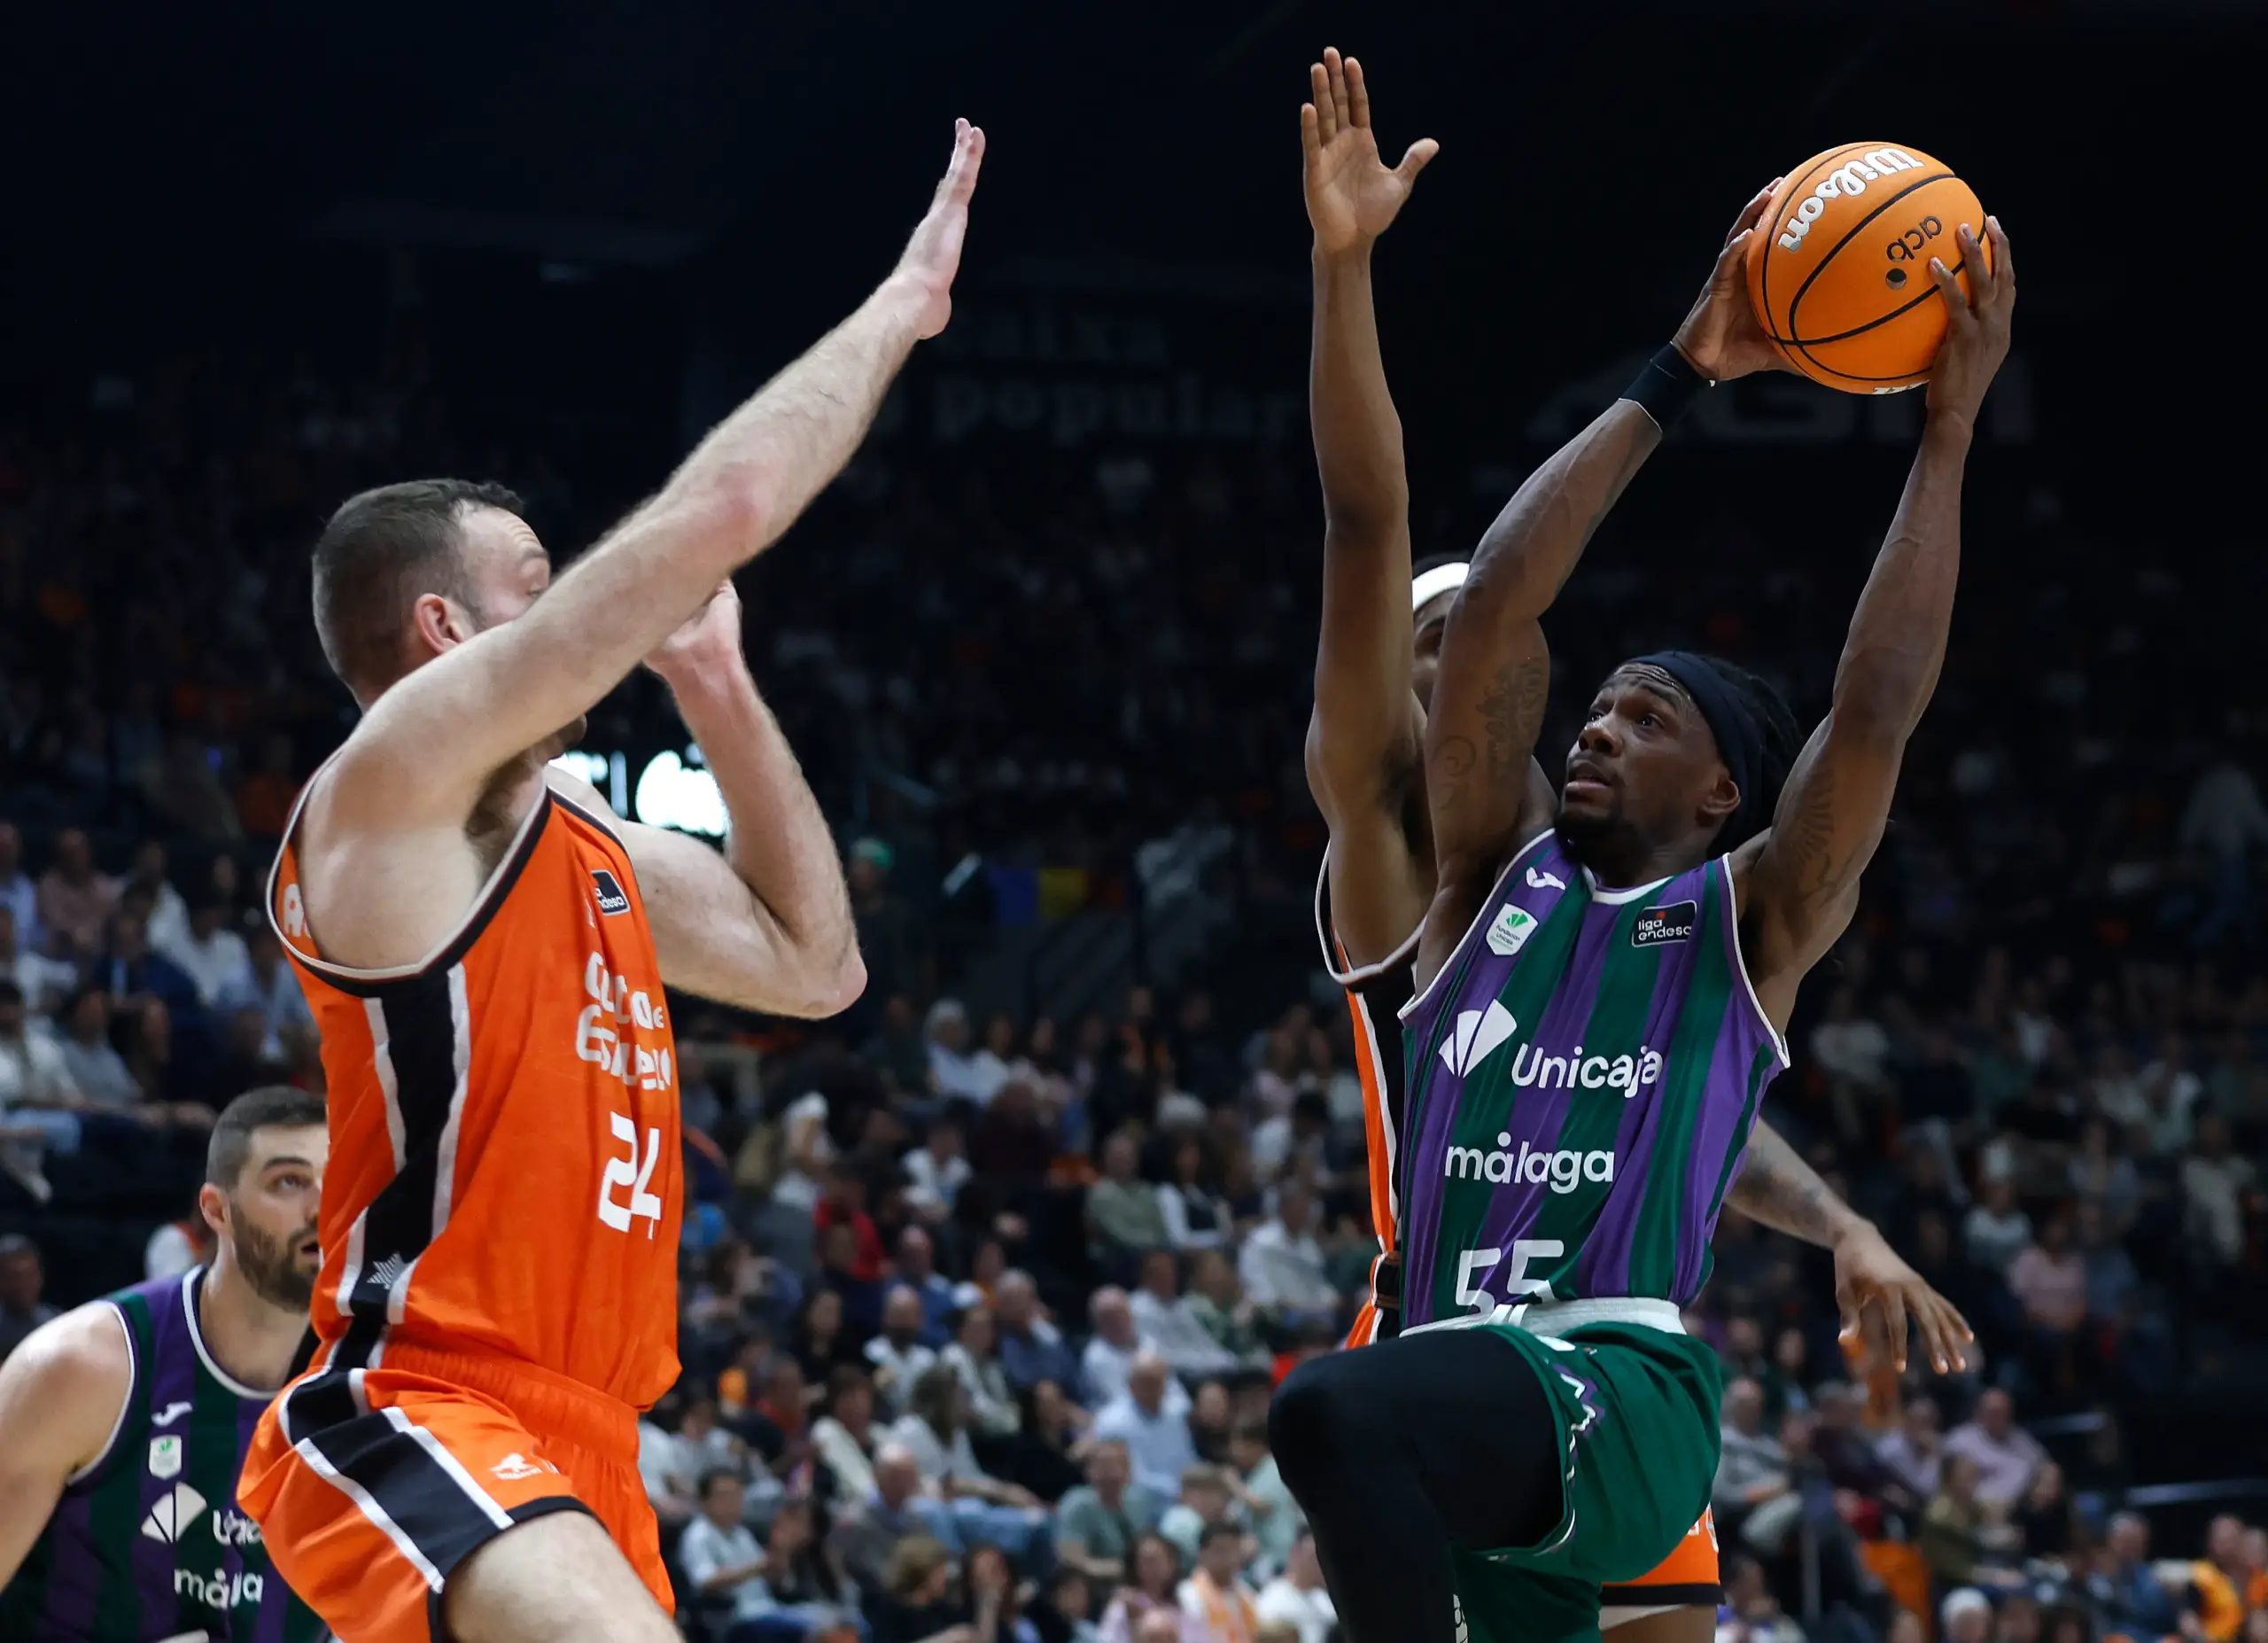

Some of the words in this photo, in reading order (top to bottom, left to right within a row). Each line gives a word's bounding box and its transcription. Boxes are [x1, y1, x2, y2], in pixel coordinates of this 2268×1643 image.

[1776, 147, 1925, 253] Wilson
[1886, 216, 1942, 262] acb
[930, 369, 1304, 445] popular
[1638, 918, 1663, 931] liga
[1638, 926, 1692, 941] endesa
[1511, 1043, 1663, 1099] Unicaja
[1455, 1239, 1565, 1315] 55
